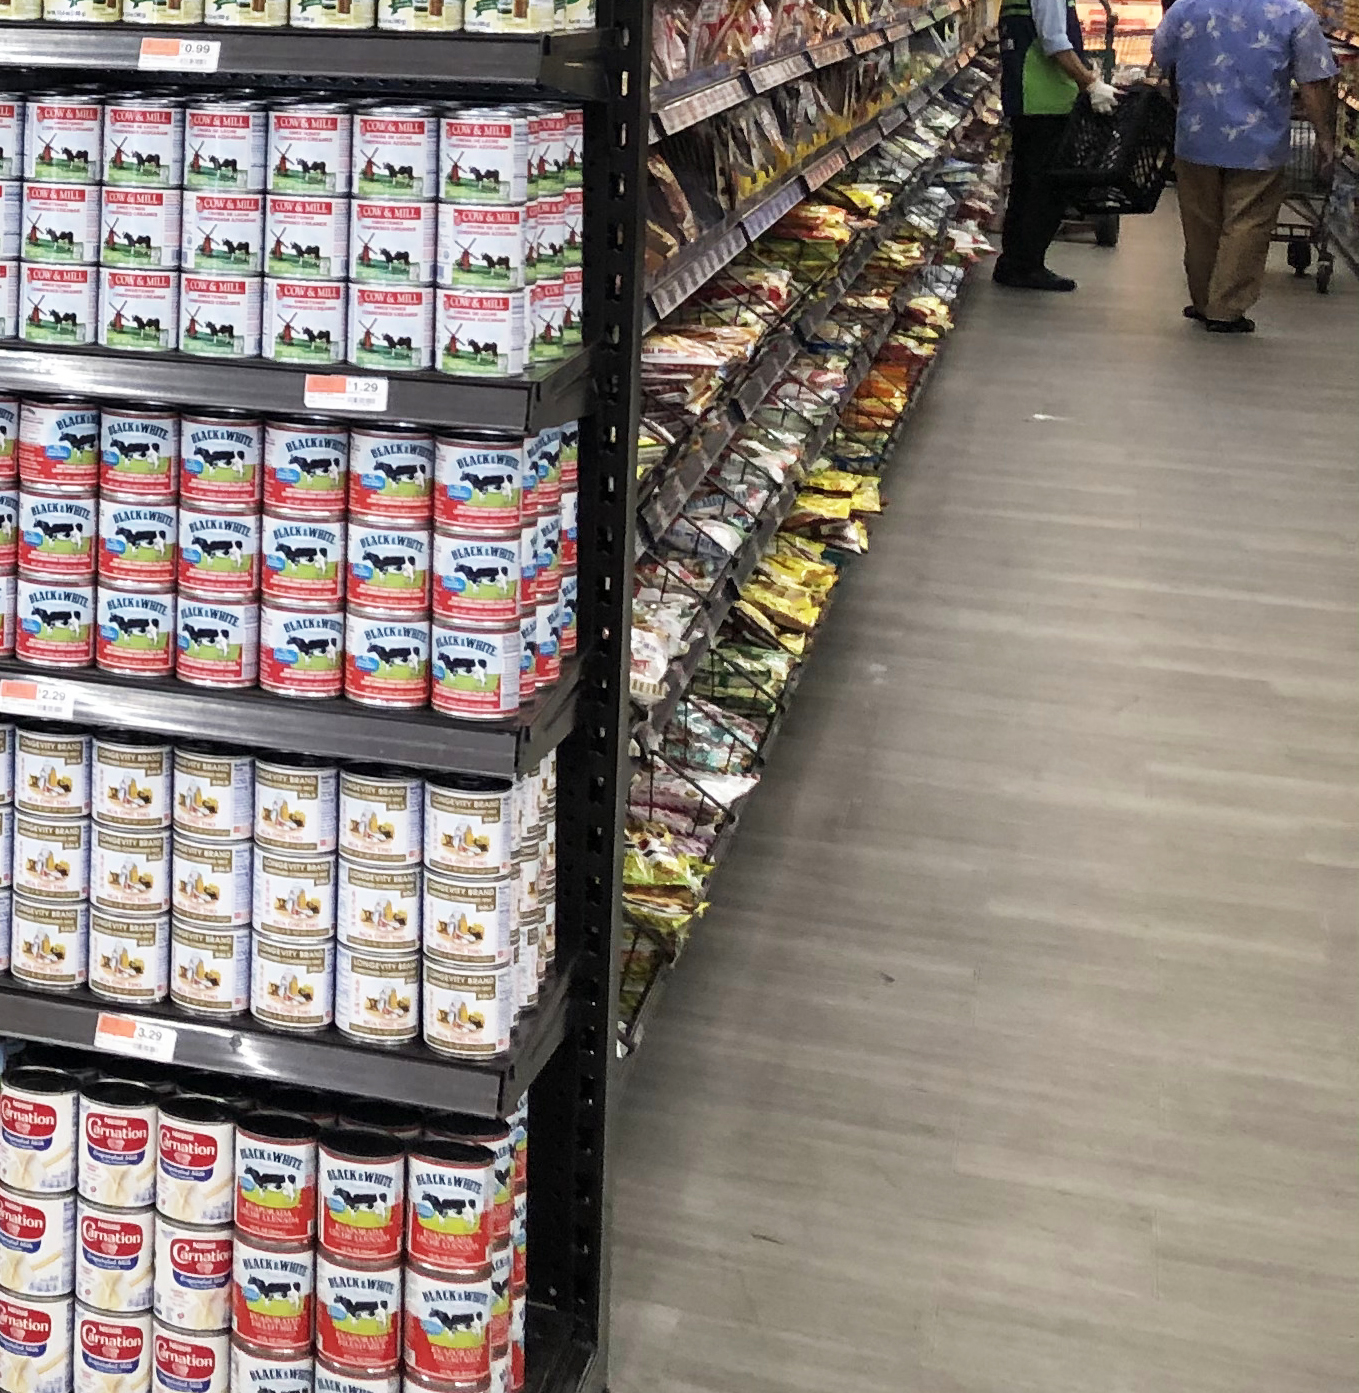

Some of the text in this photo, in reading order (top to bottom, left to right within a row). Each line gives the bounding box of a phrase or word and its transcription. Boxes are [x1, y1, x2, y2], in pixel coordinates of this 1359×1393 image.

[452, 124, 507, 137] COW & MILL
[204, 197, 257, 210] COW & MILL
[398, 536, 424, 553] WHITE
[64, 591, 88, 607] WHITE
[57, 741, 81, 751] BRAND
[130, 923, 155, 933] BRAND
[2, 1098, 55, 1126] Carnation
[87, 1117, 147, 1140] Carnation
[160, 1131, 215, 1157] Carnation
[364, 1172, 392, 1187] WHITE
[453, 1176, 482, 1194] WHITE
[83, 1220, 141, 1245] Carnation
[280, 1260, 308, 1276] WHITE
[82, 1323, 141, 1348] Carnation
[156, 1340, 213, 1367] Carnation
